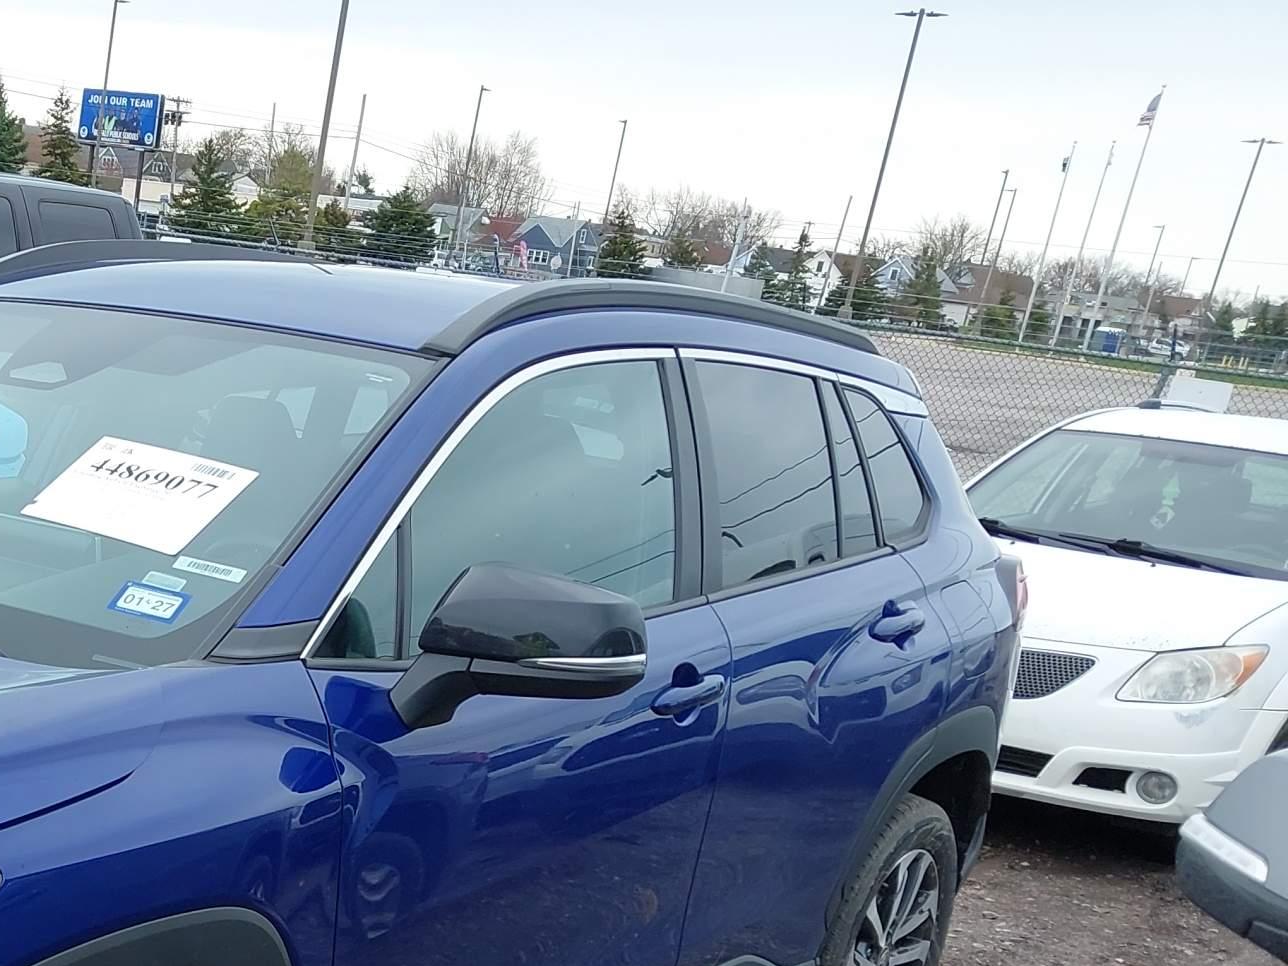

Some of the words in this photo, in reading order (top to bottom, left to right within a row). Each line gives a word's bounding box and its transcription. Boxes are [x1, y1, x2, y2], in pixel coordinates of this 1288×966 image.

[110, 96, 127, 106] OUR
[130, 98, 153, 108] TEAM
[90, 458, 219, 498] 44869077
